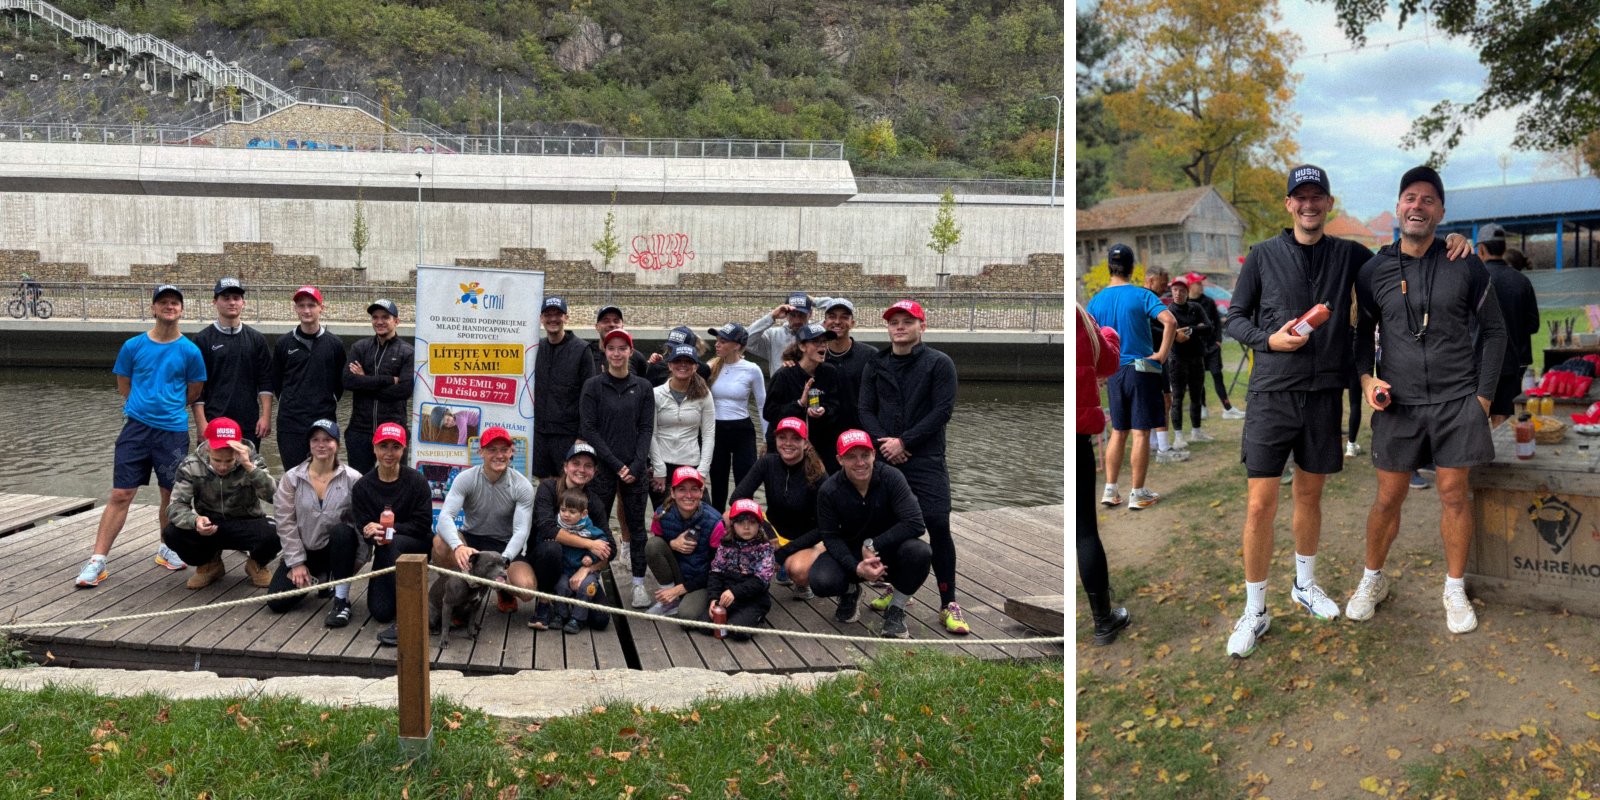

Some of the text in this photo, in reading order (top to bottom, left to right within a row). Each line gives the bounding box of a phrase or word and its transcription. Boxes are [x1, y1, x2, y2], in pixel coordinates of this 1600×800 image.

[1295, 168, 1320, 178] HUSKI
[483, 294, 505, 310] emil
[478, 318, 527, 327] PODPORUJEME
[436, 323, 520, 334] MLADÉ HANDICAPOVANÉ
[457, 332, 499, 340] SPORTOVCE!
[433, 347, 519, 361] LÍTEJTE V TOM
[453, 360, 500, 371] S NÁMI!
[446, 377, 506, 390] DMS EMIL 90
[455, 388, 478, 397] číslo
[480, 390, 491, 398] 87
[493, 391, 509, 399] 777
[417, 450, 465, 458] INSPIRUJEME
[1514, 556, 1600, 578] SANREMO
